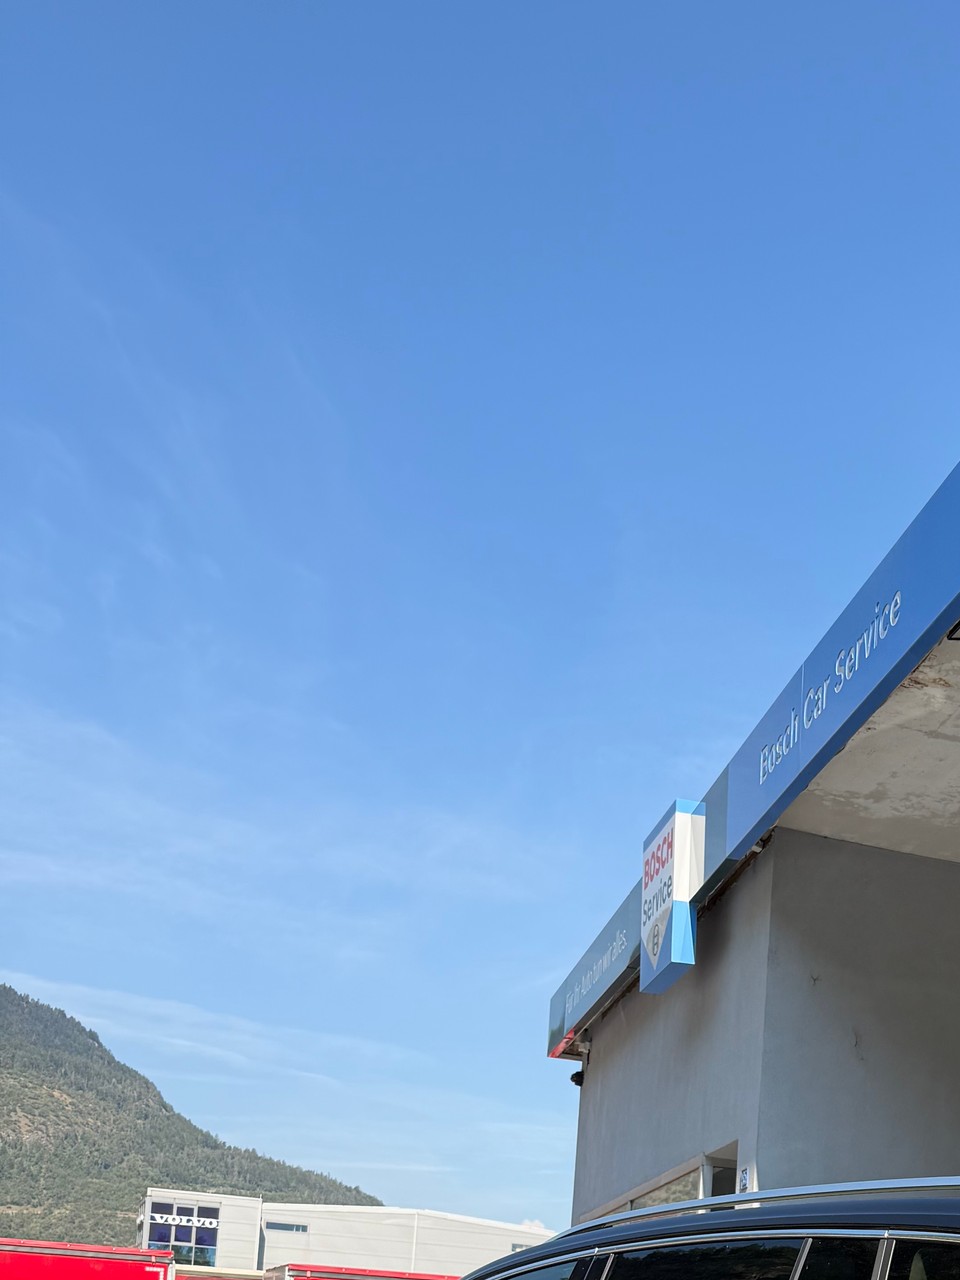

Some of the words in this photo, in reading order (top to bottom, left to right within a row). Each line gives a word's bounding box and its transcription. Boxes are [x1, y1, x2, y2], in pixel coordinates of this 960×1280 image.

[759, 707, 799, 785] Bosch
[803, 674, 831, 729] Car
[833, 590, 901, 693] Service
[644, 827, 673, 890] BOSCH
[642, 875, 673, 926] Service
[153, 1214, 217, 1228] VOLVO
